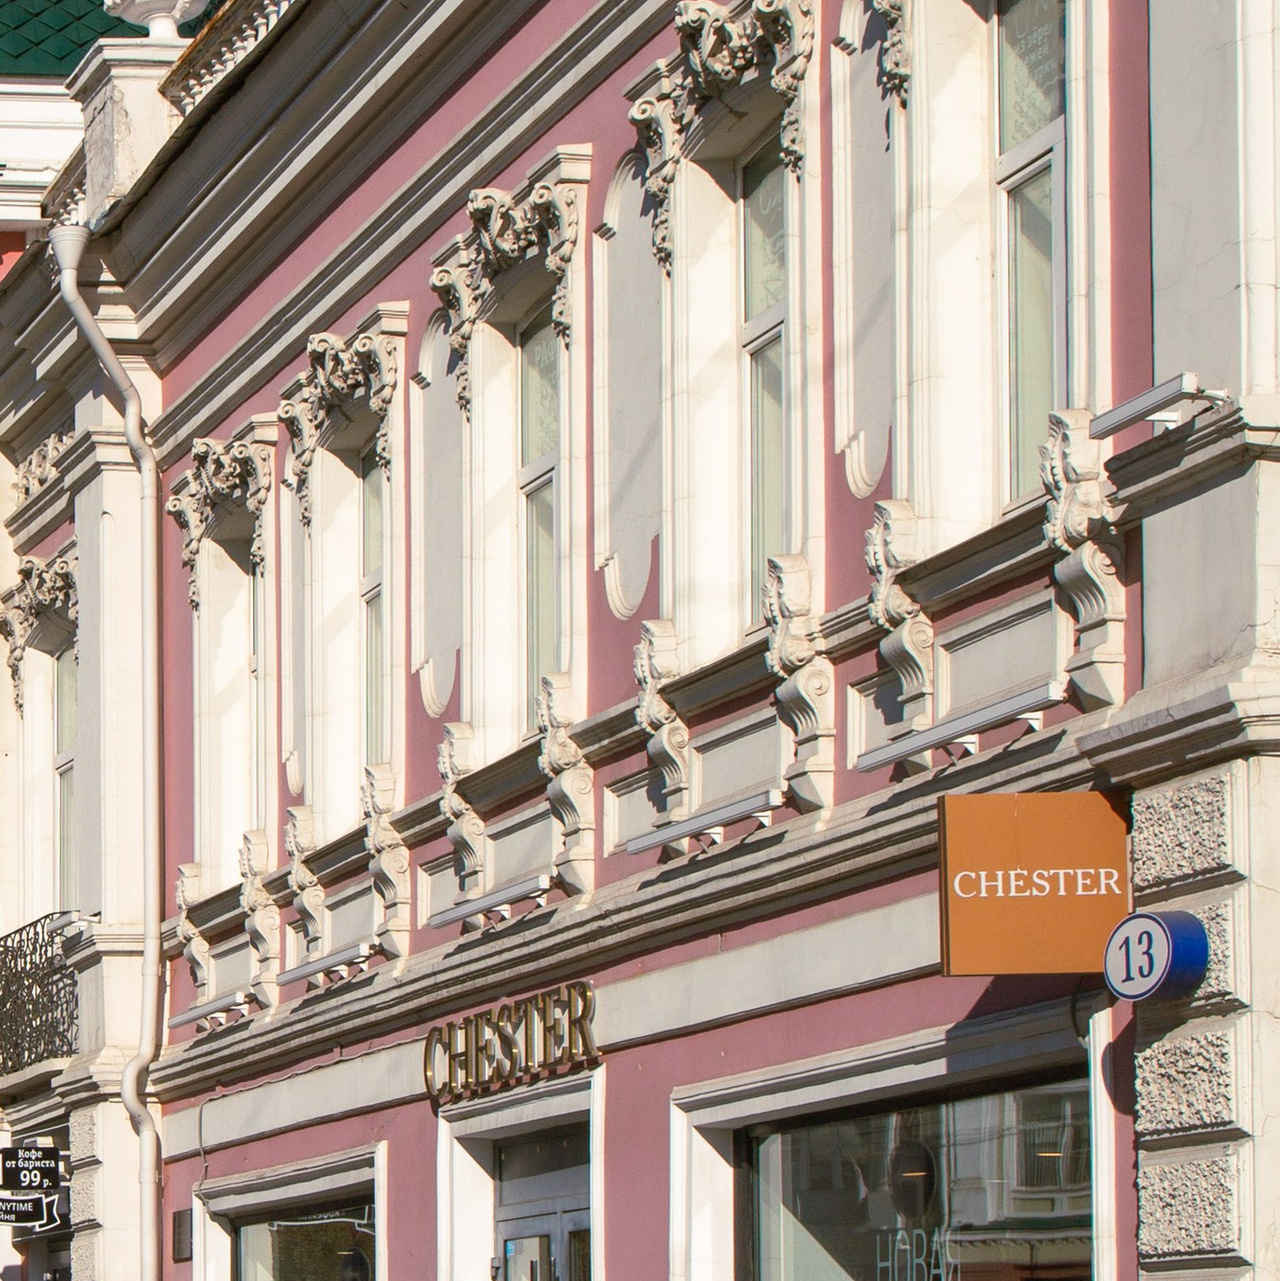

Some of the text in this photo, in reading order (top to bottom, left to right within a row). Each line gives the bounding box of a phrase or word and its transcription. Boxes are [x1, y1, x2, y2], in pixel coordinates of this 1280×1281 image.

[953, 867, 1122, 898] CHESTER
[1118, 930, 1155, 984] 13
[424, 980, 603, 1099] CHESTER
[5, 1159, 55, 1169] от бариста
[18, 1149, 43, 1160] Кофе
[20, 1170, 41, 1187] 99
